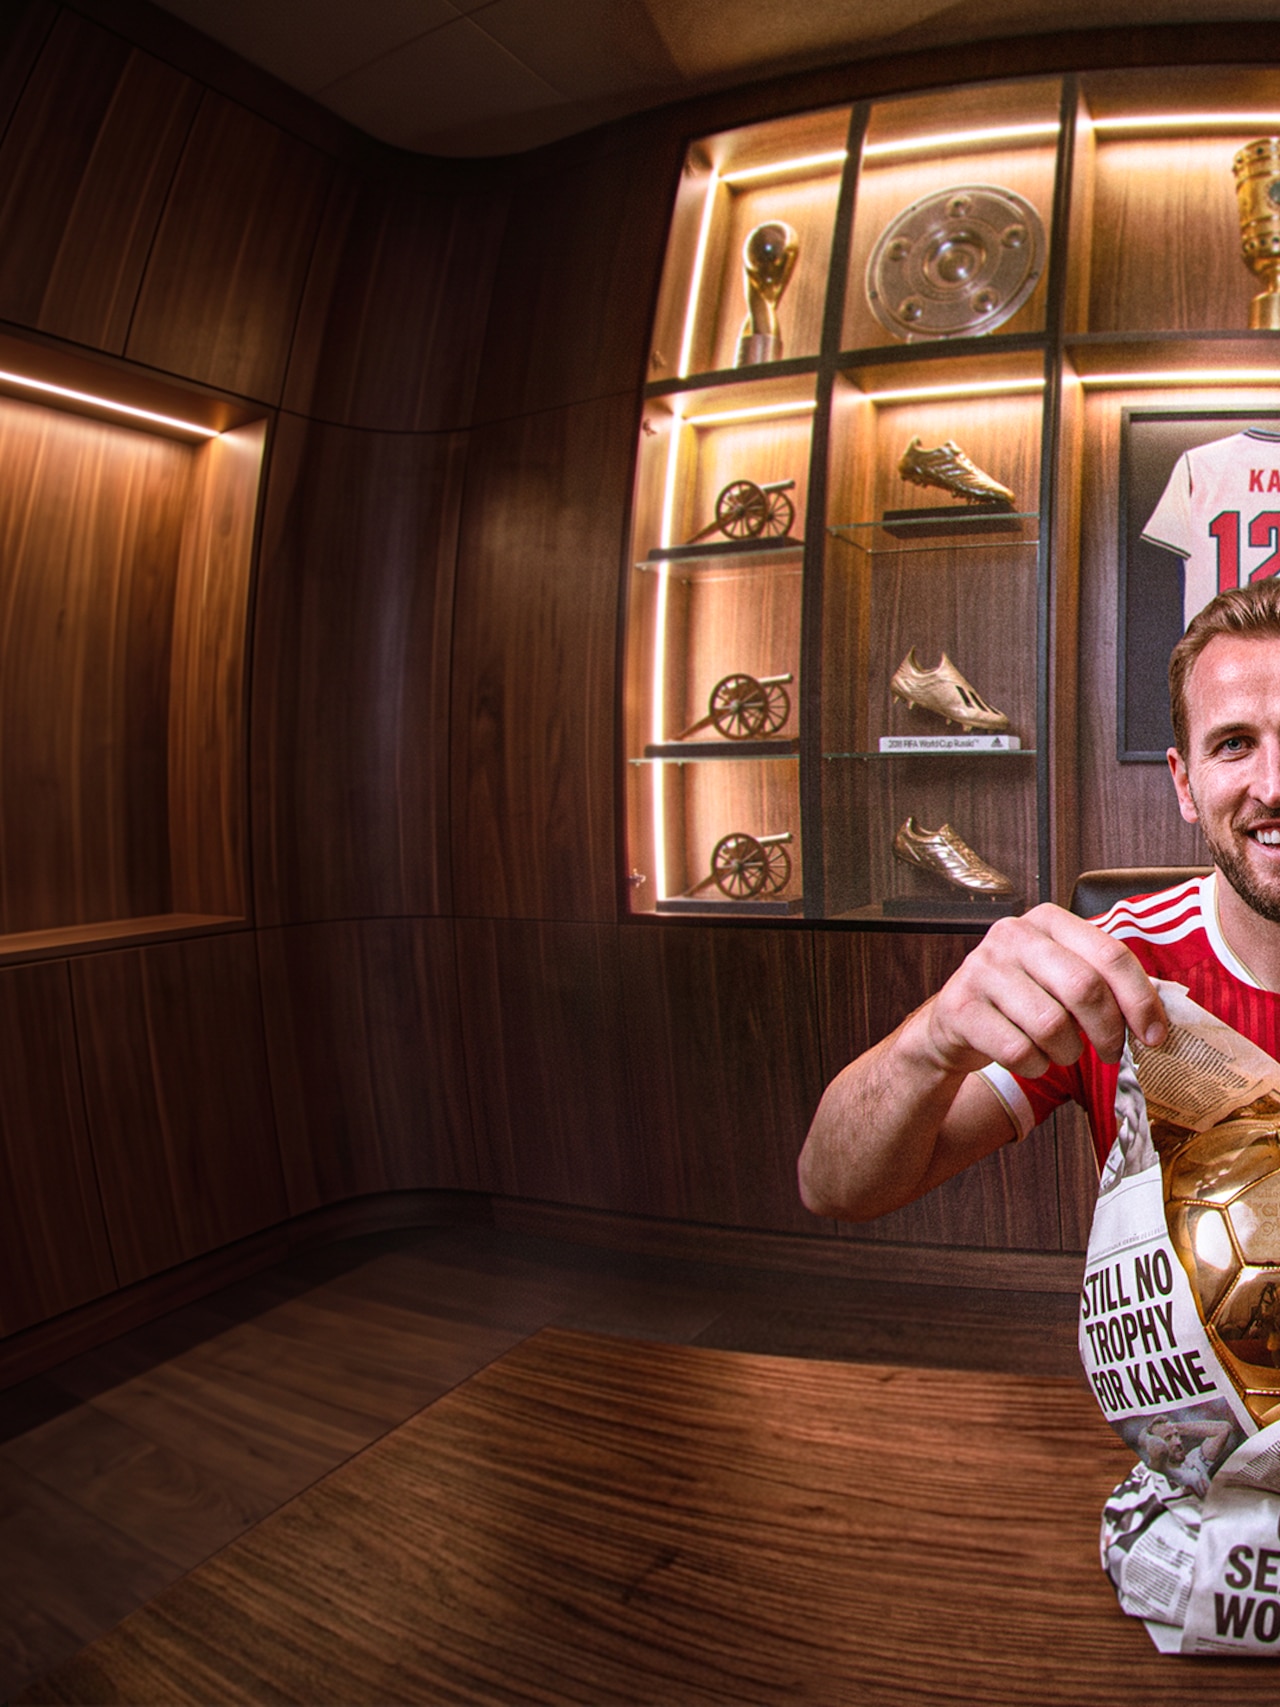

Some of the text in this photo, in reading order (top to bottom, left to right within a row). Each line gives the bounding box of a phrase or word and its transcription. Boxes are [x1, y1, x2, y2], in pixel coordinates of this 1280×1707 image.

[1082, 1248, 1174, 1320] STILL NO
[1086, 1301, 1178, 1367] TROPHY
[1091, 1350, 1217, 1414] FOR KANE
